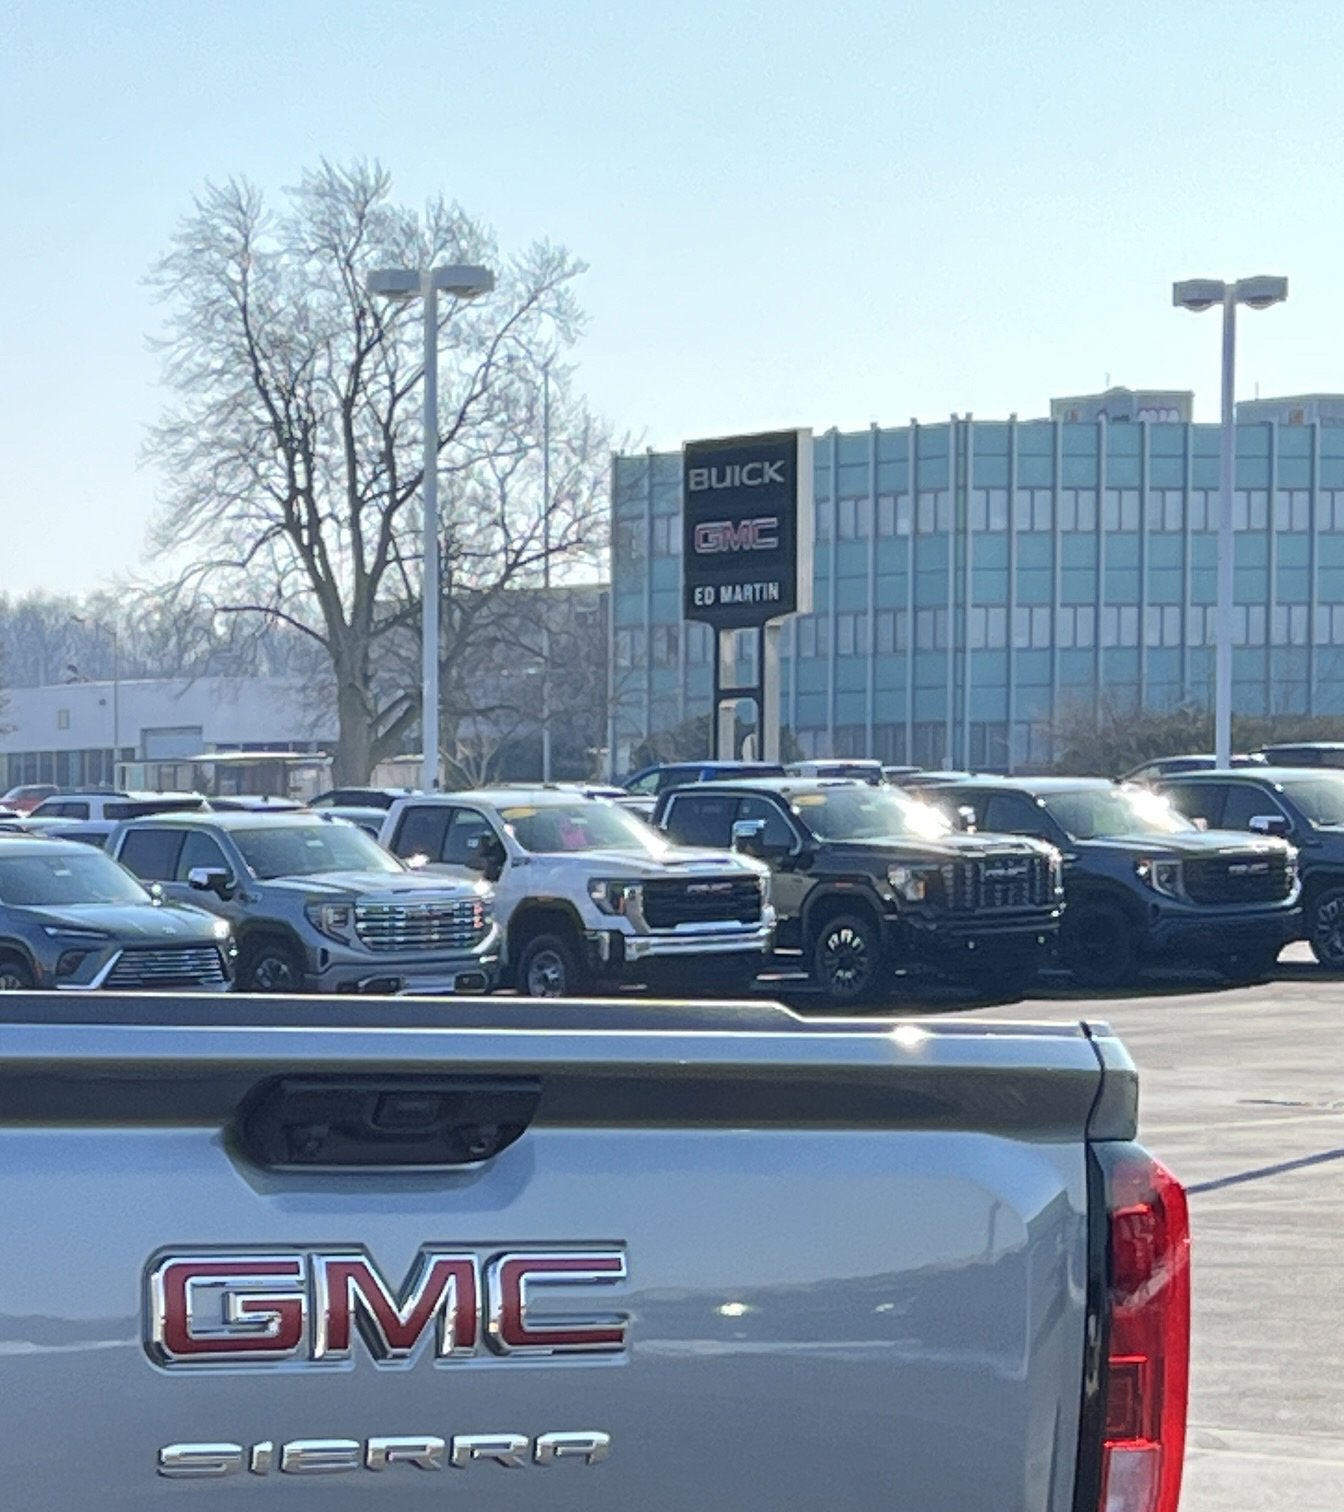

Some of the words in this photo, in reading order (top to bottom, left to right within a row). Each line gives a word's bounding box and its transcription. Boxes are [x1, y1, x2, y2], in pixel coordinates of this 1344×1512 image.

[688, 460, 785, 491] BUICK
[694, 517, 779, 554] GMC
[694, 587, 715, 606] ED
[720, 582, 780, 604] MARTIN
[148, 1247, 627, 1365] GMC
[157, 1430, 611, 1478] SIERRA
